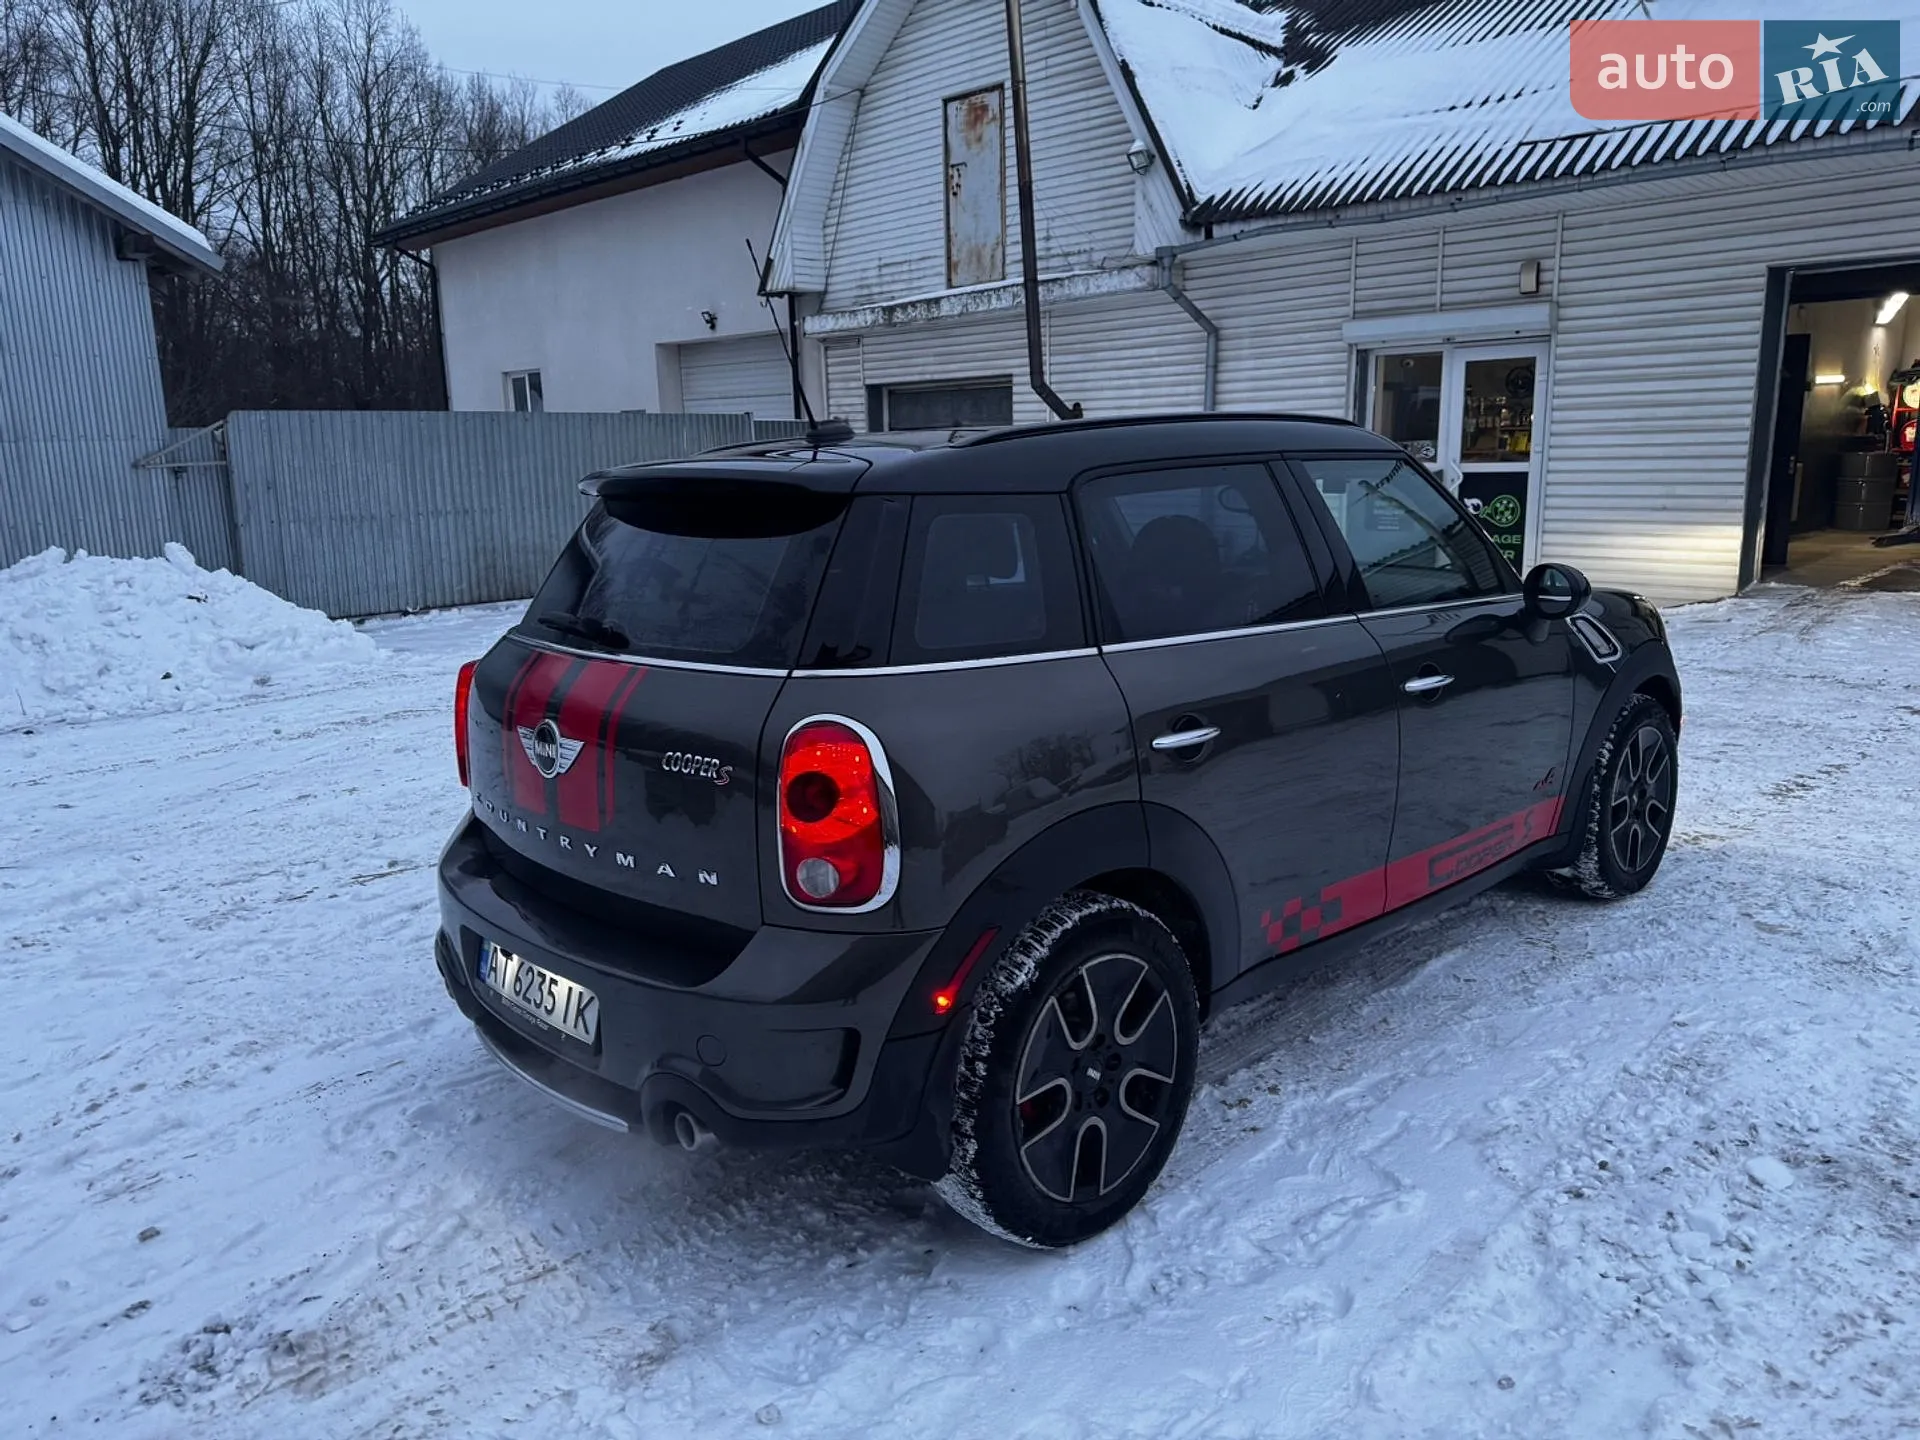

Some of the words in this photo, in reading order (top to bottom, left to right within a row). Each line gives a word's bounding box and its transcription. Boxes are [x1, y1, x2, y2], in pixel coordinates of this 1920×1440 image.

[487, 946, 514, 989] AT
[513, 961, 559, 1016] 6235
[563, 985, 596, 1035] IK
